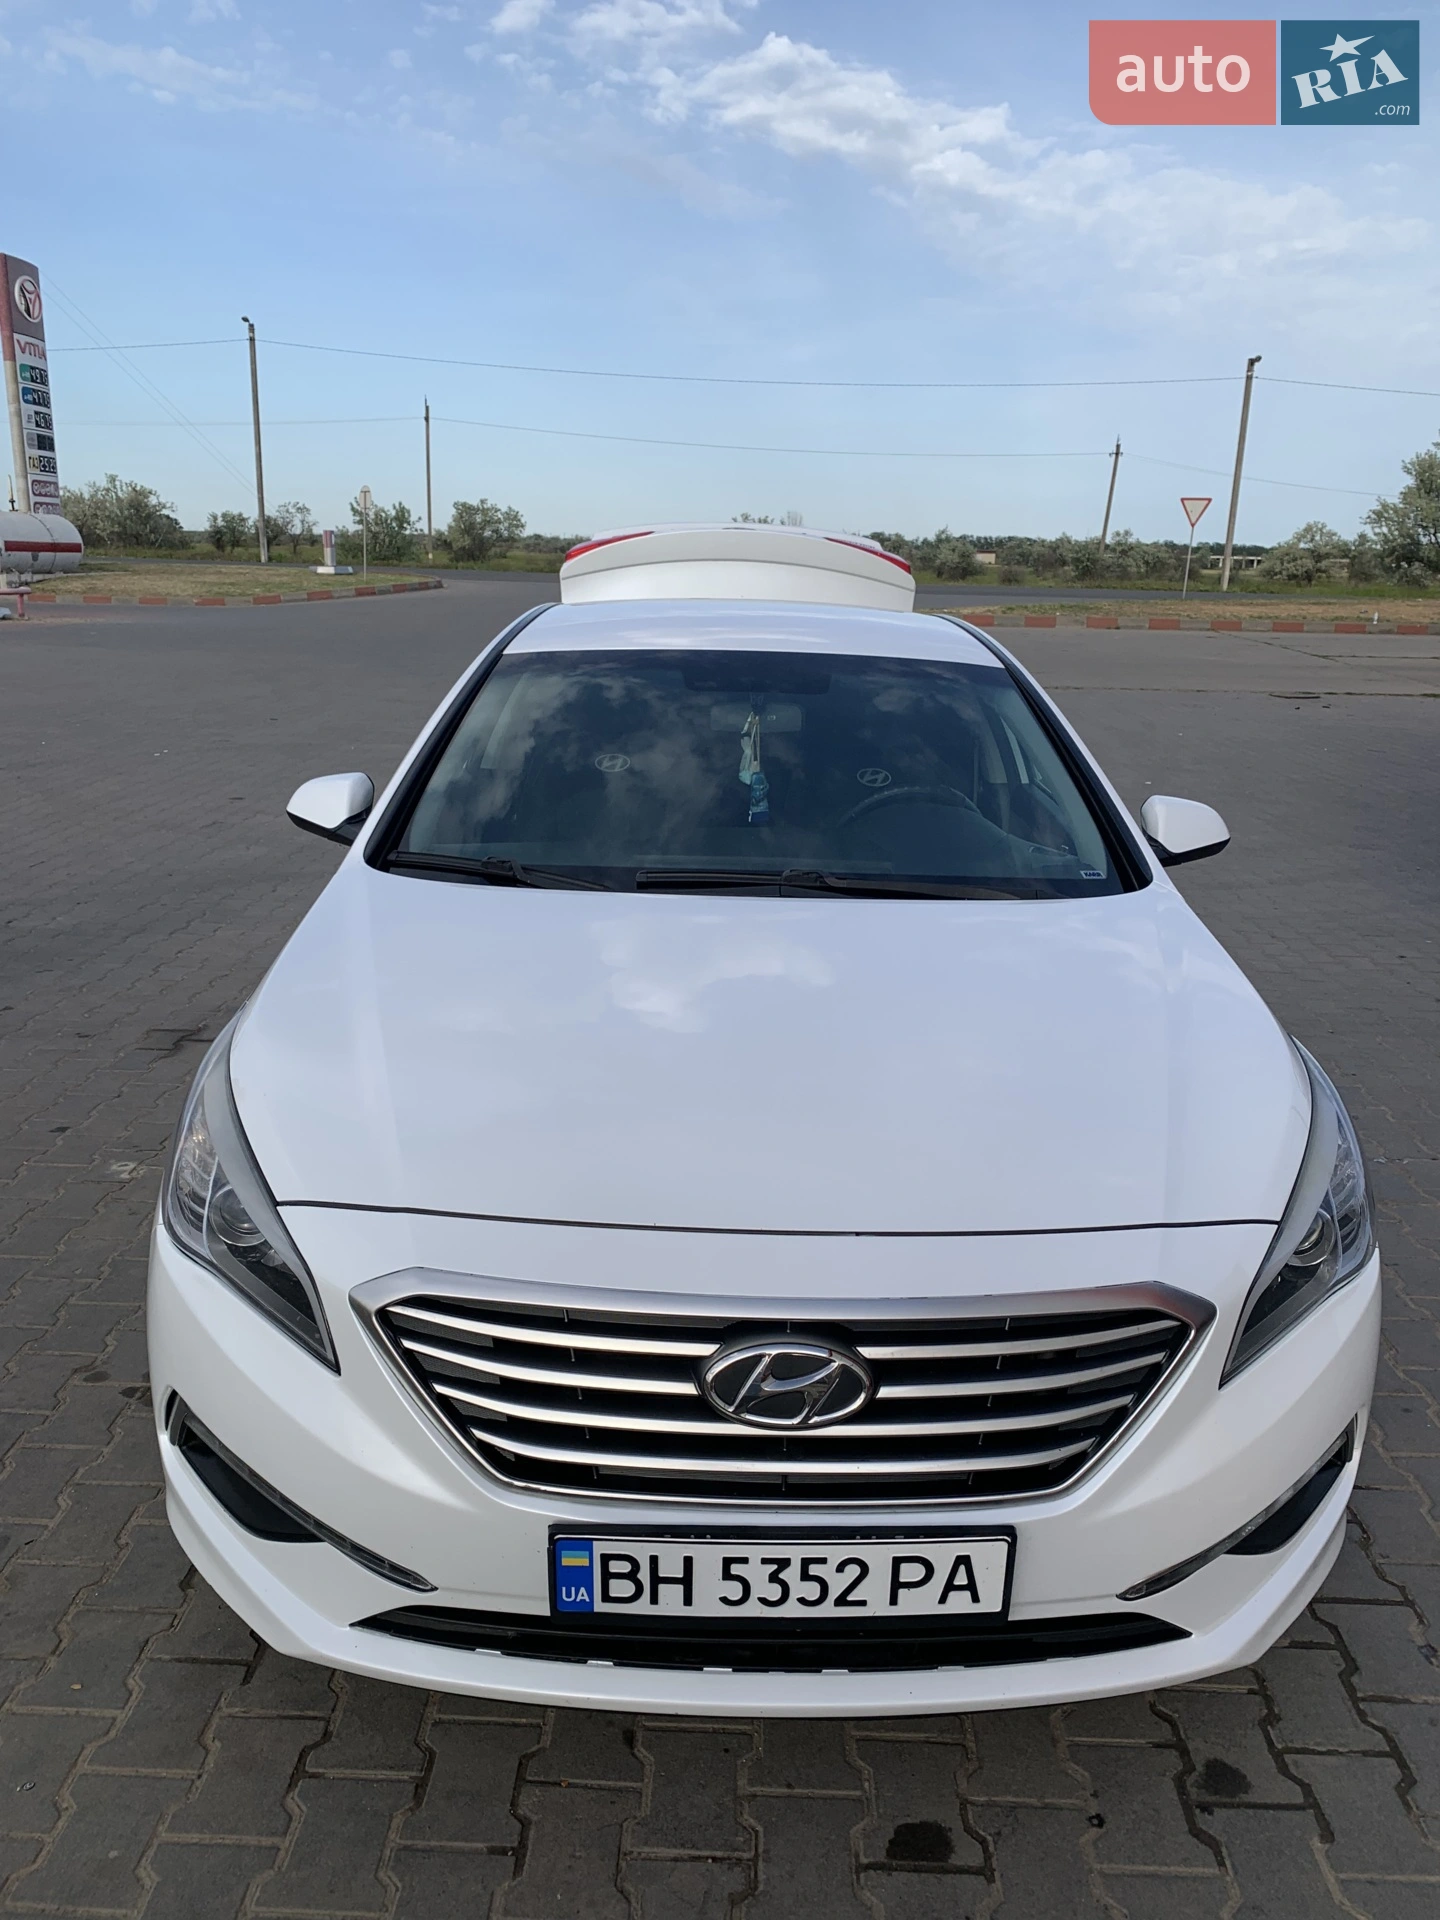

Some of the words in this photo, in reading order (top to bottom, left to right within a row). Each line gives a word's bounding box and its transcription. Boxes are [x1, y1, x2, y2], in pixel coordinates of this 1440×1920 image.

[561, 1585, 590, 1603] UA
[600, 1552, 694, 1607] BH
[717, 1555, 871, 1608] 5352
[888, 1553, 981, 1606] PA
